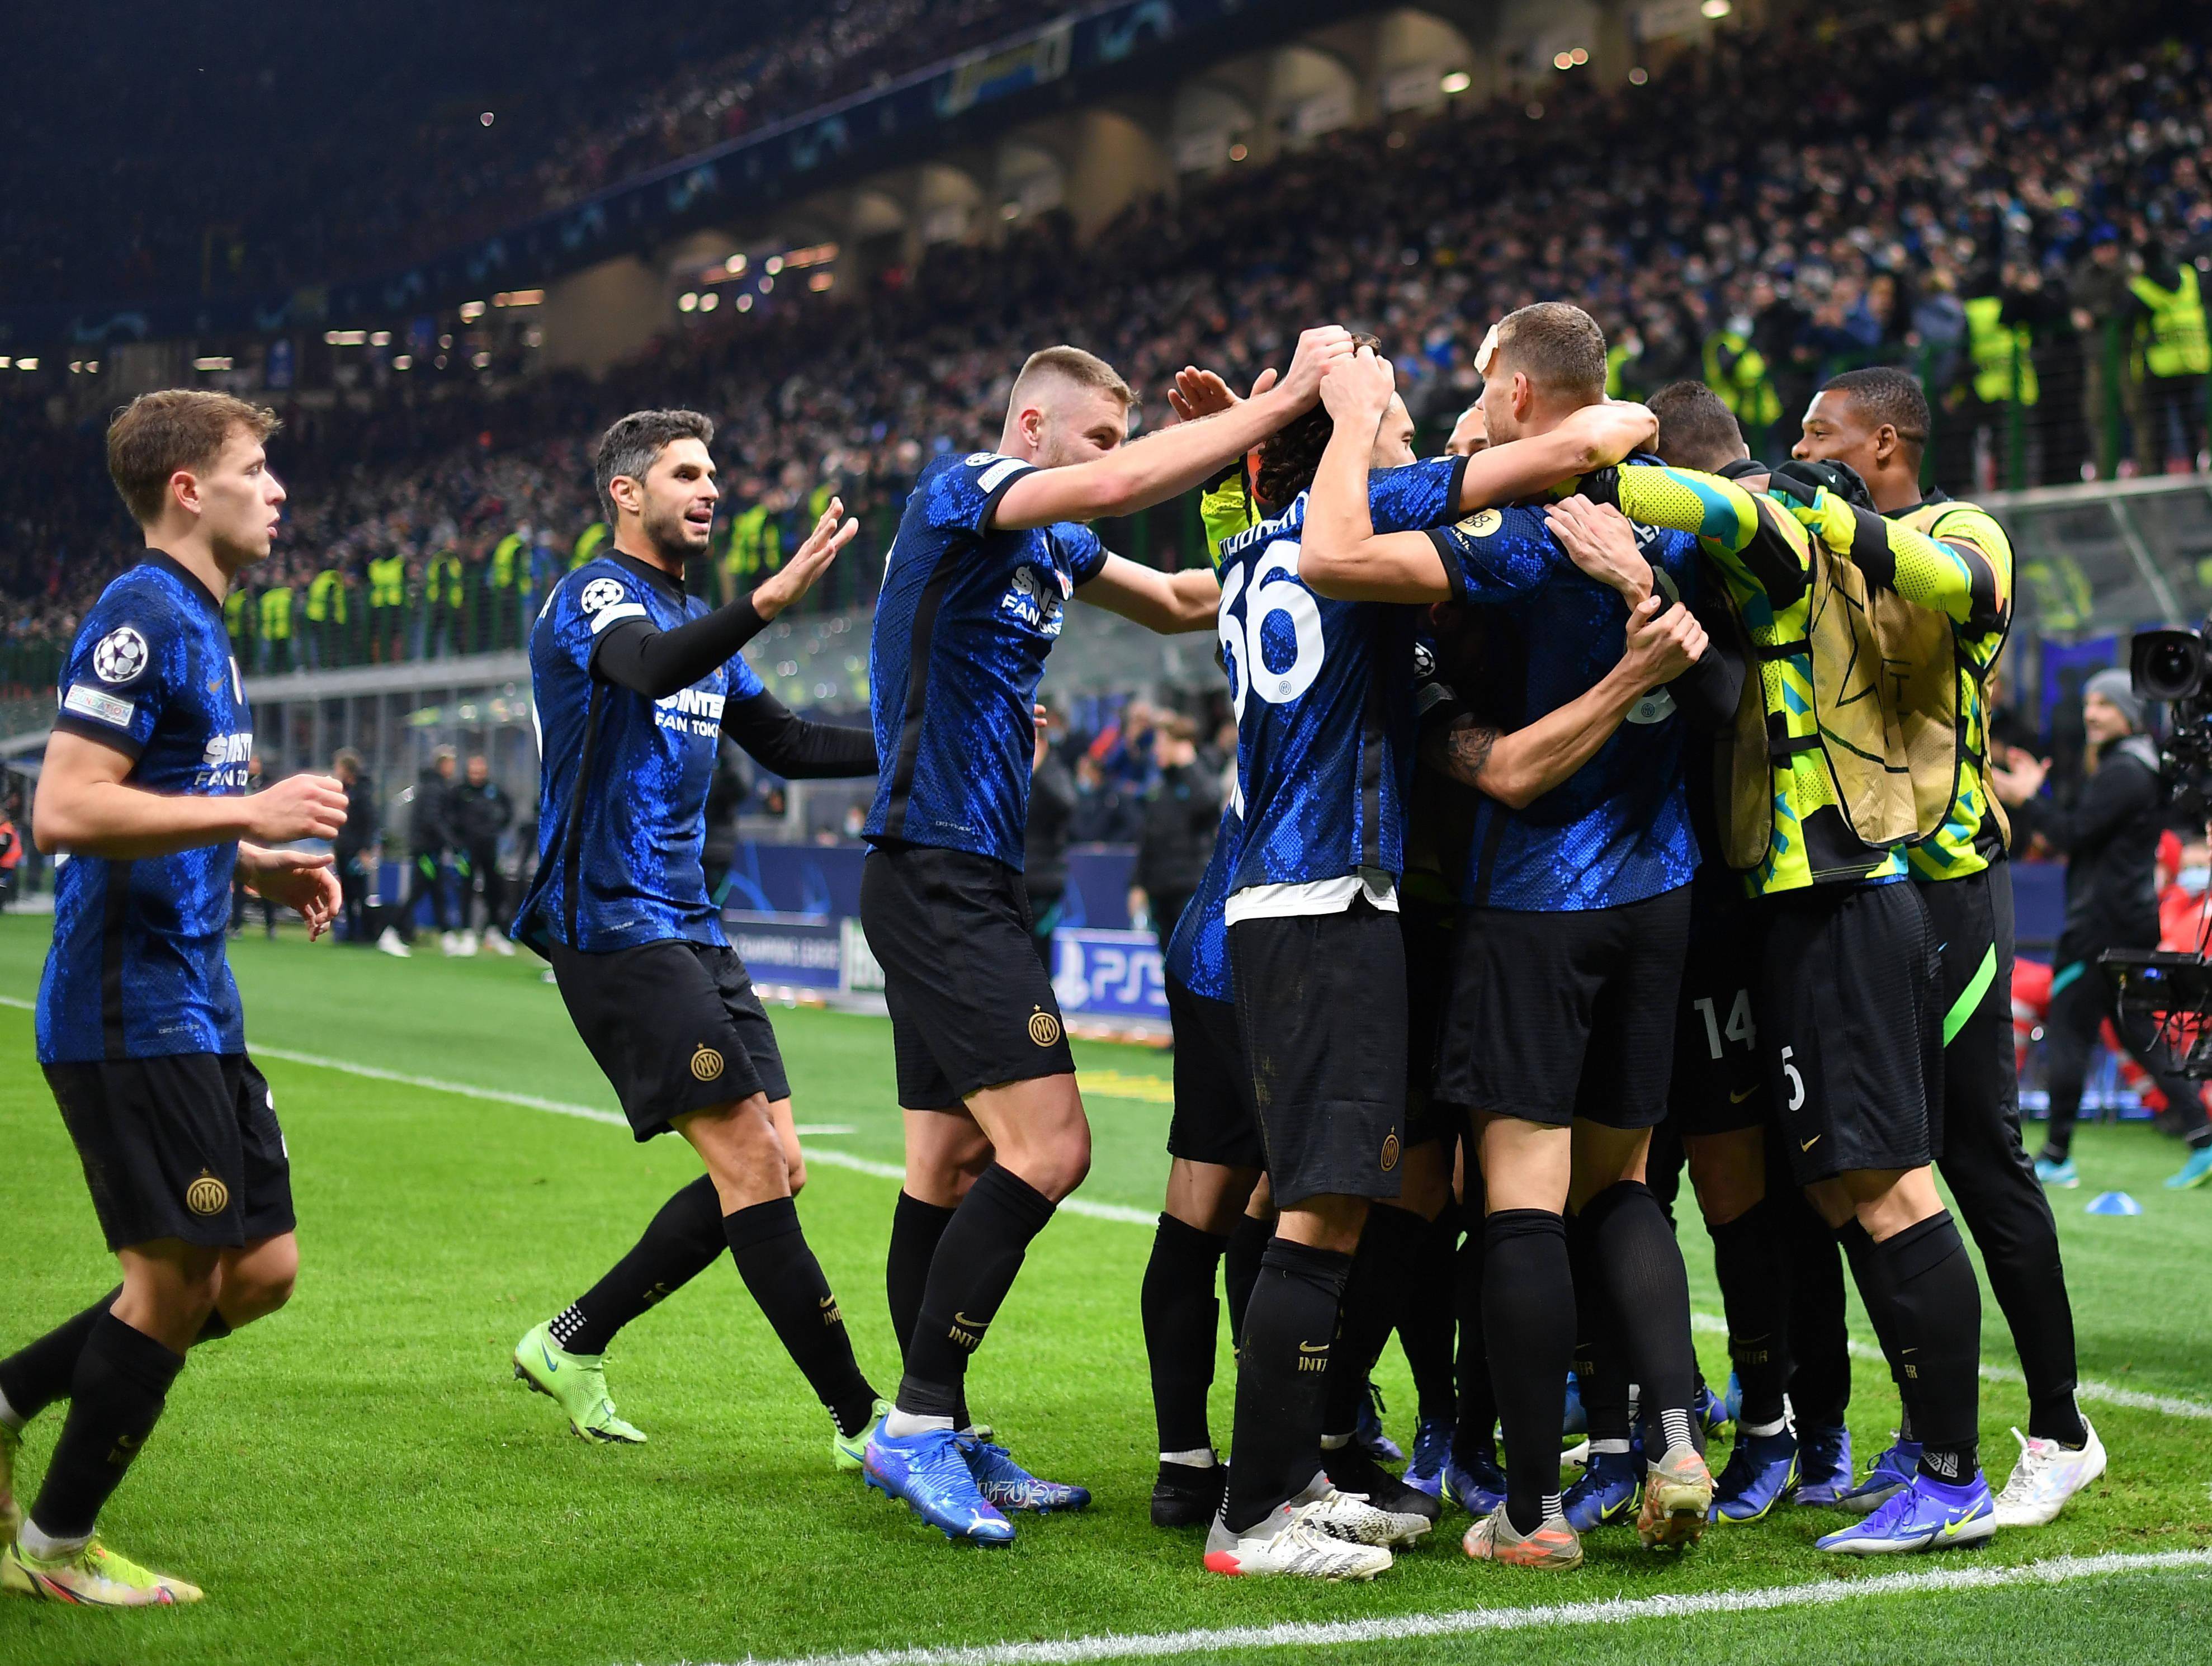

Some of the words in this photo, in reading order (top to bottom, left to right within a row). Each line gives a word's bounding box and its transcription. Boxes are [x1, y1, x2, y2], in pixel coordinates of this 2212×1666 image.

[1001, 594, 1040, 626] FAN
[655, 711, 688, 733] FAN
[692, 719, 720, 739] TOK
[193, 770, 234, 786] FAN
[1694, 988, 1756, 1060] 14
[1781, 1045, 1805, 1111] 5
